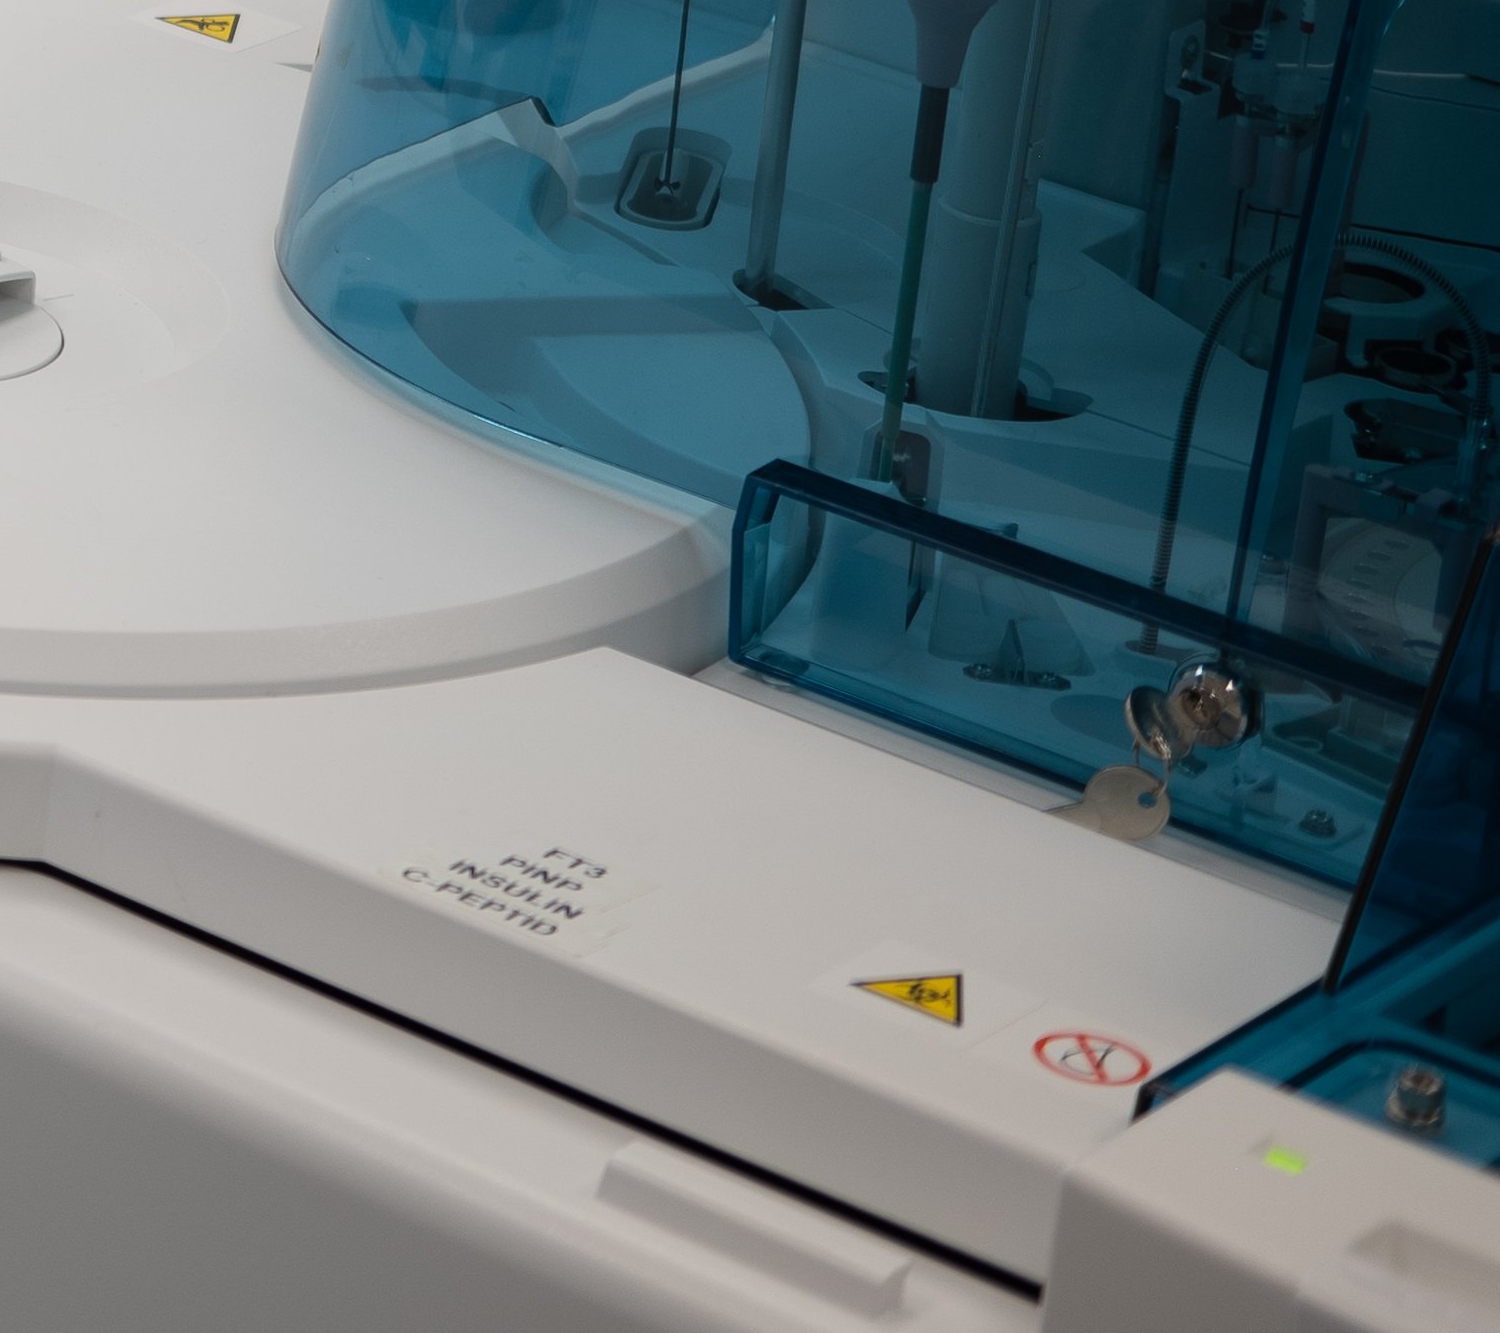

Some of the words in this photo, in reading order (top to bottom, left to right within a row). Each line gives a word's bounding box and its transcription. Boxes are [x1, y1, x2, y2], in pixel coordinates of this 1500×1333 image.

[449, 859, 583, 920] INSULIN
[543, 847, 607, 880] FT3
[401, 866, 559, 936] C-PEPTID
